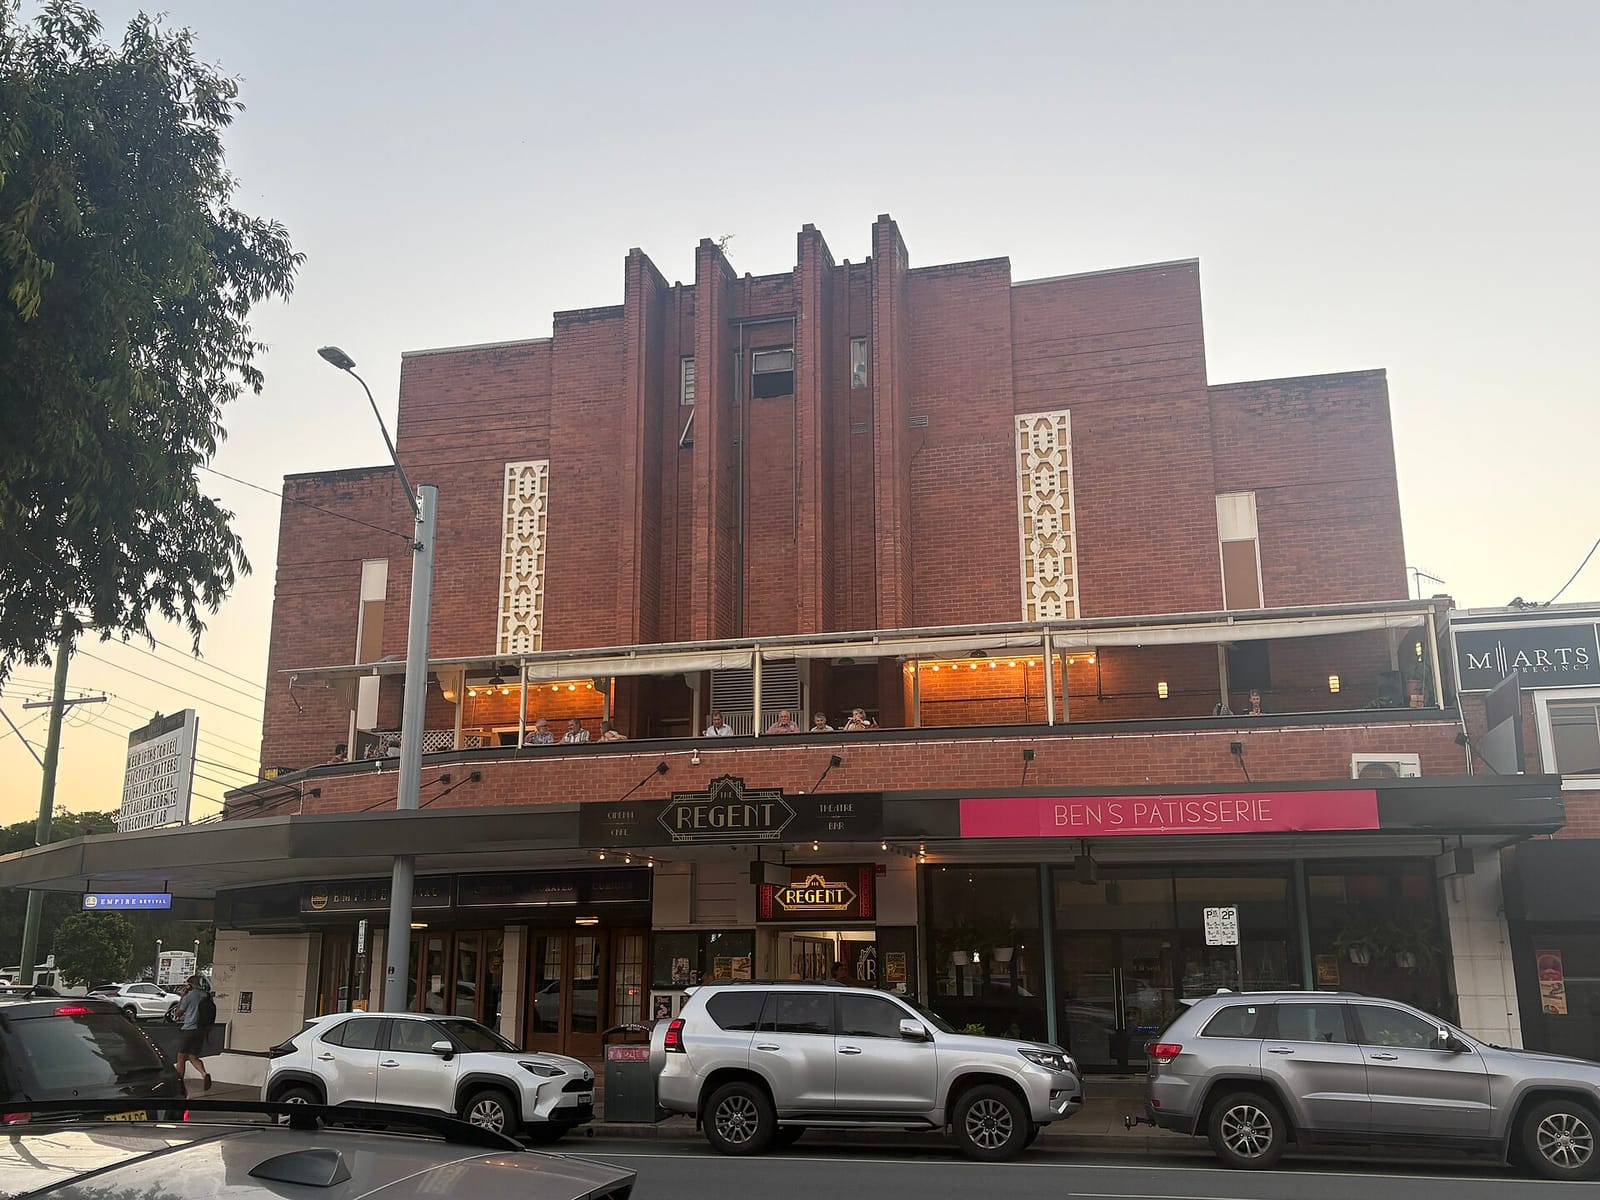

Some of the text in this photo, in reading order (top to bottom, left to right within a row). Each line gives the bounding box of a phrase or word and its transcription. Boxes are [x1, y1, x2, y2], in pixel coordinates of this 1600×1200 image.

[1466, 647, 1589, 670] M ARTS
[1512, 664, 1591, 673] PRECINCT
[820, 804, 854, 813] THEATRE
[1054, 799, 1273, 826] BEN'S PATISSERIE
[676, 803, 775, 829] REGENT
[828, 822, 845, 831] BAR
[786, 889, 844, 904] REGENT
[1221, 910, 1235, 920] 2P
